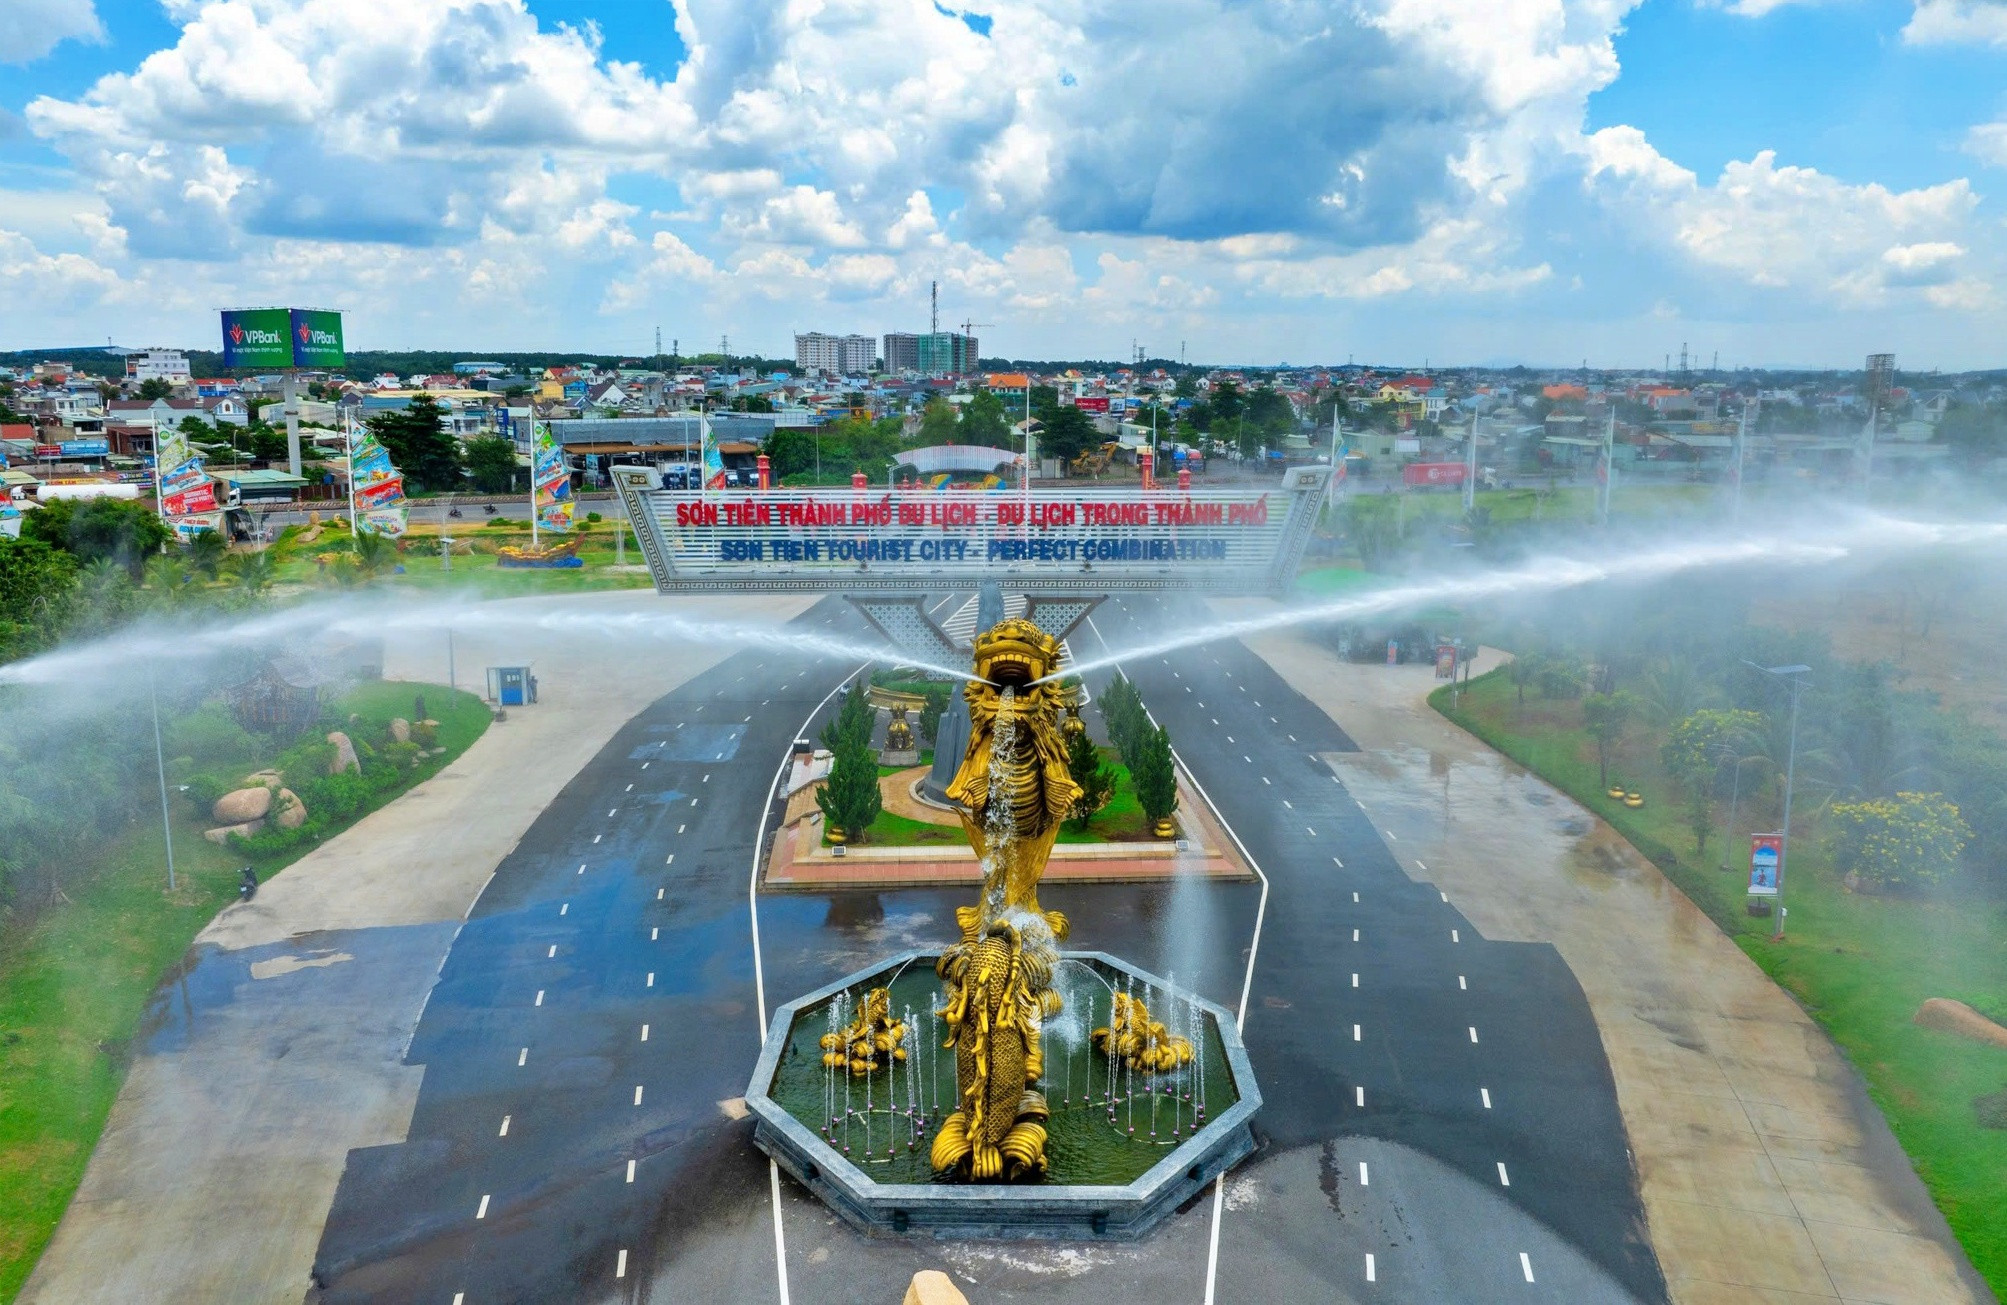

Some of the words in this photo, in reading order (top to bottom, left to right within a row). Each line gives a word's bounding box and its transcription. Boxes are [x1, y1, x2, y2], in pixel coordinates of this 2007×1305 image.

[245, 330, 282, 344] VPBank
[311, 330, 337, 345] VPBank
[676, 498, 718, 526] SƠN
[723, 497, 771, 526] TIÊN
[776, 497, 846, 526] THÀNH
[851, 492, 892, 526] PHỐ
[898, 503, 925, 526] DU
[931, 502, 976, 531] LỊCH
[997, 503, 1024, 526] DU
[1030, 503, 1076, 531] LỊCH
[1081, 502, 1149, 526] TRONG
[1154, 497, 1223, 526] THÀNH
[1228, 492, 1269, 526] PHỐ
[826, 538, 914, 561] TOURIST
[920, 539, 968, 561] CITY
[987, 538, 1079, 562] PERFECT
[1083, 538, 1226, 561] COMBINATION
